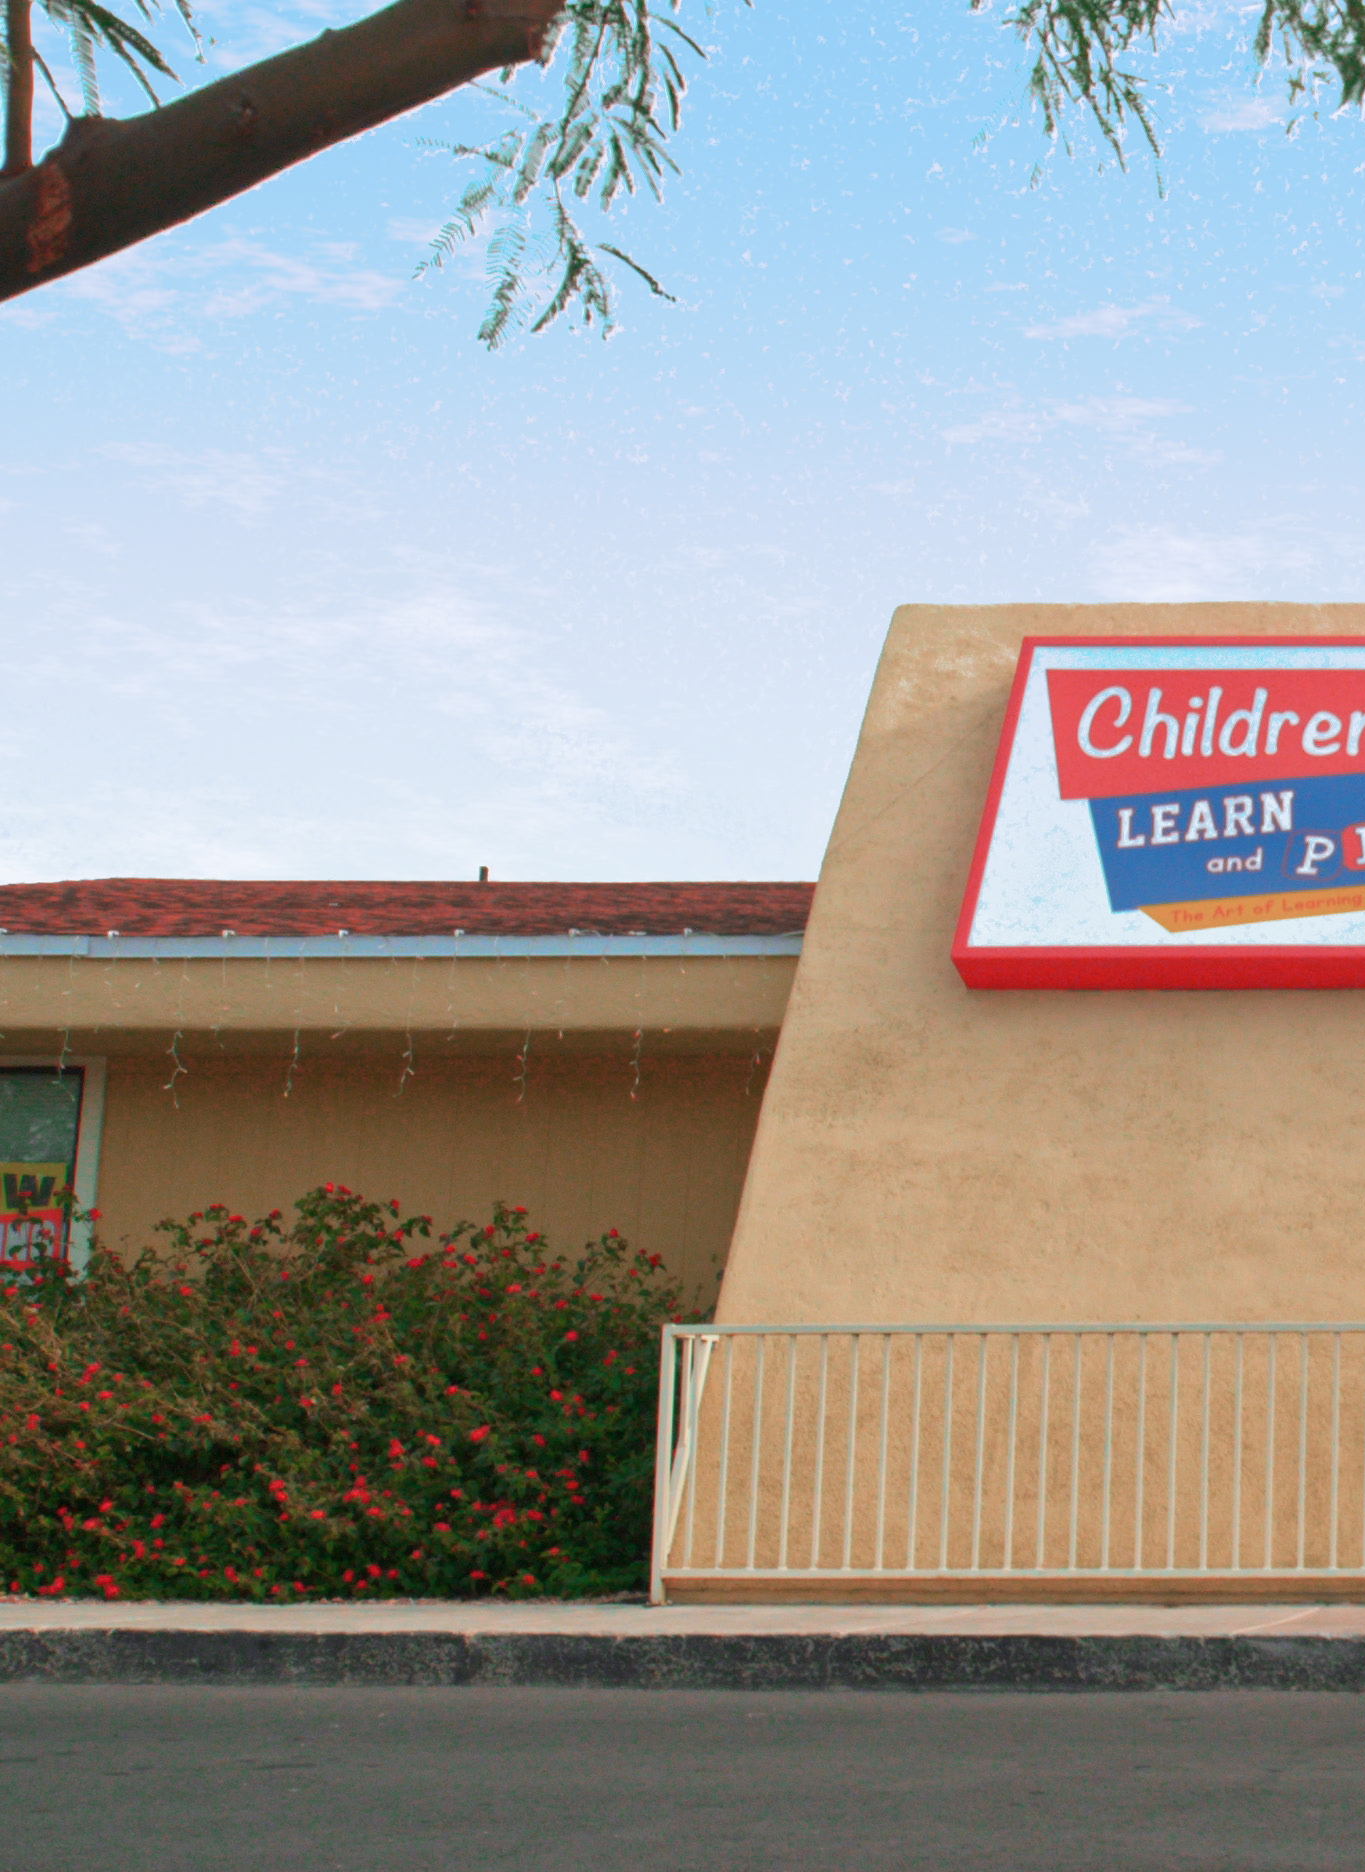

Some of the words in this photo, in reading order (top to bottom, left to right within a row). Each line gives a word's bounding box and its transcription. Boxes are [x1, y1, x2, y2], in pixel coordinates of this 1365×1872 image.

[1117, 790, 1295, 849] LEARN
[1207, 847, 1263, 873] and
[1171, 909, 1204, 924] The
[1212, 904, 1244, 920] Art
[1252, 899, 1274, 914] of
[1282, 893, 1363, 913] Learning
